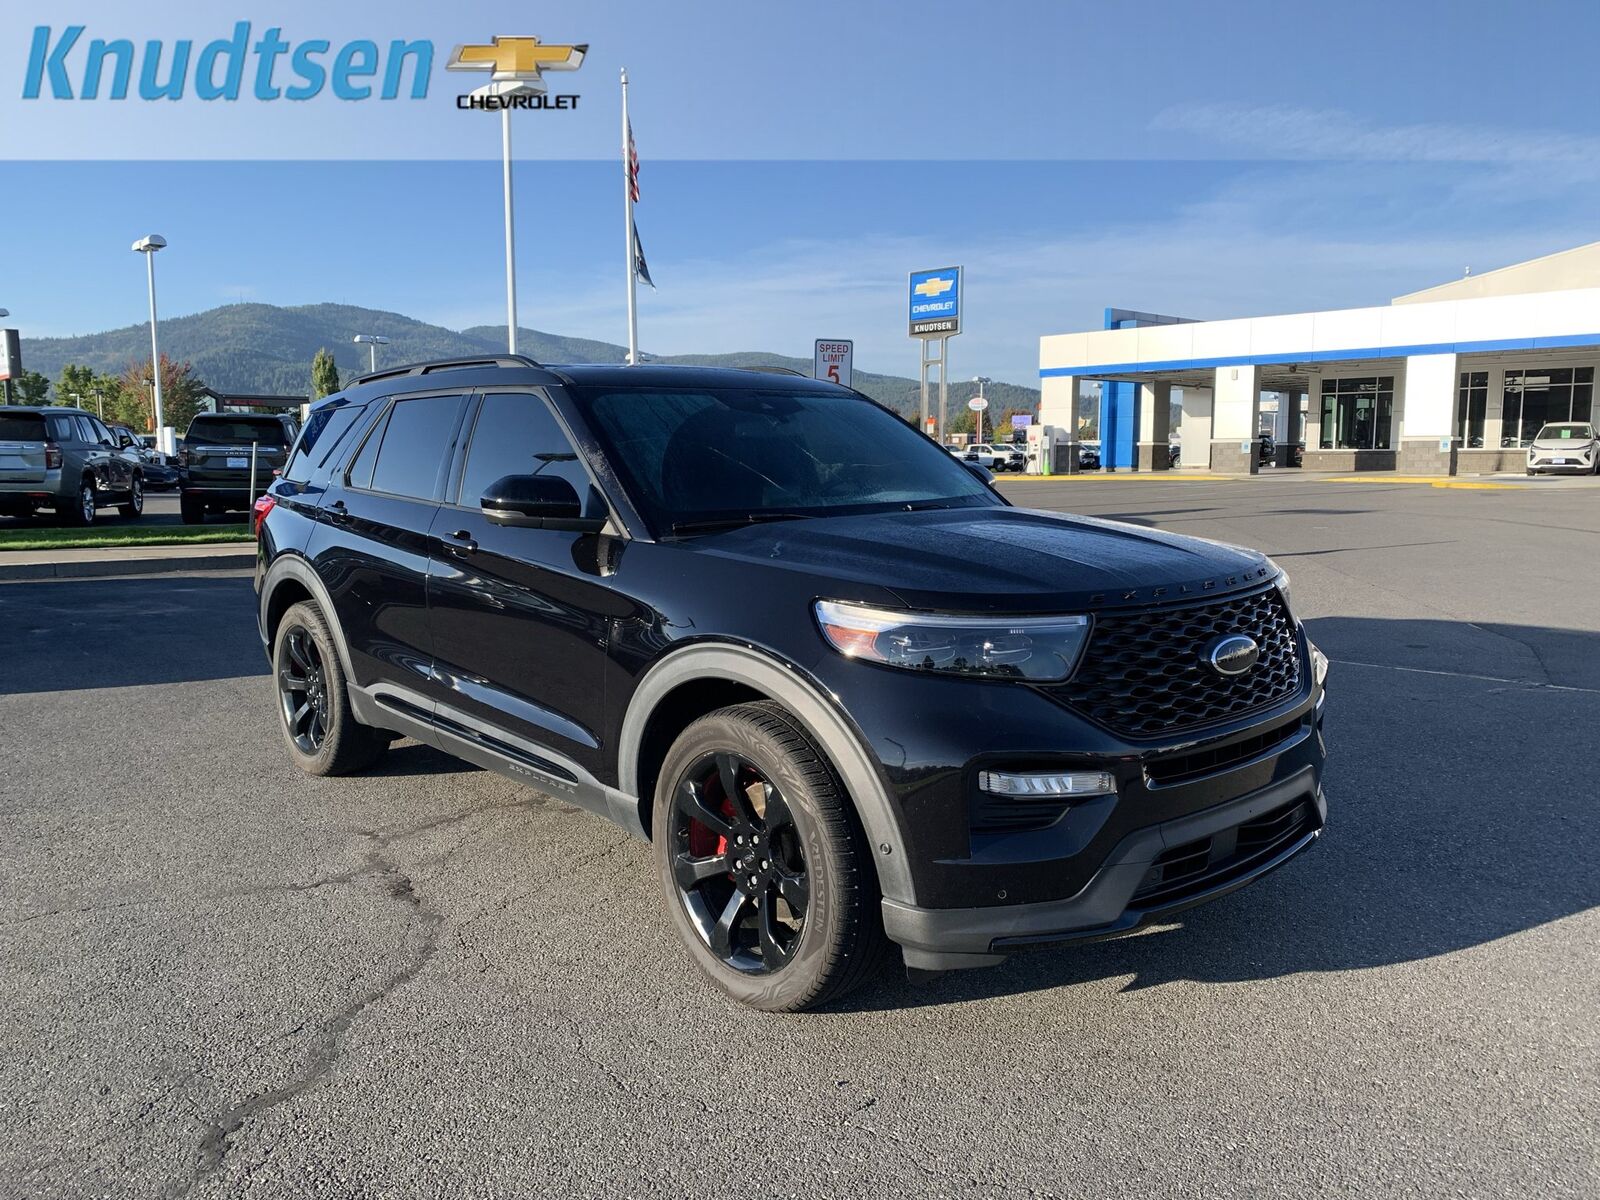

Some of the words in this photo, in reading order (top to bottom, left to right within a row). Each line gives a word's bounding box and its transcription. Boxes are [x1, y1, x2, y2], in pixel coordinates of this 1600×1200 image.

[912, 301, 954, 313] CHEVROLET
[914, 321, 952, 333] KNUDTSEN
[819, 343, 849, 354] SPEED
[822, 353, 846, 363] LIMIT
[827, 364, 840, 385] 5
[808, 831, 826, 933] VREDESTEIN
